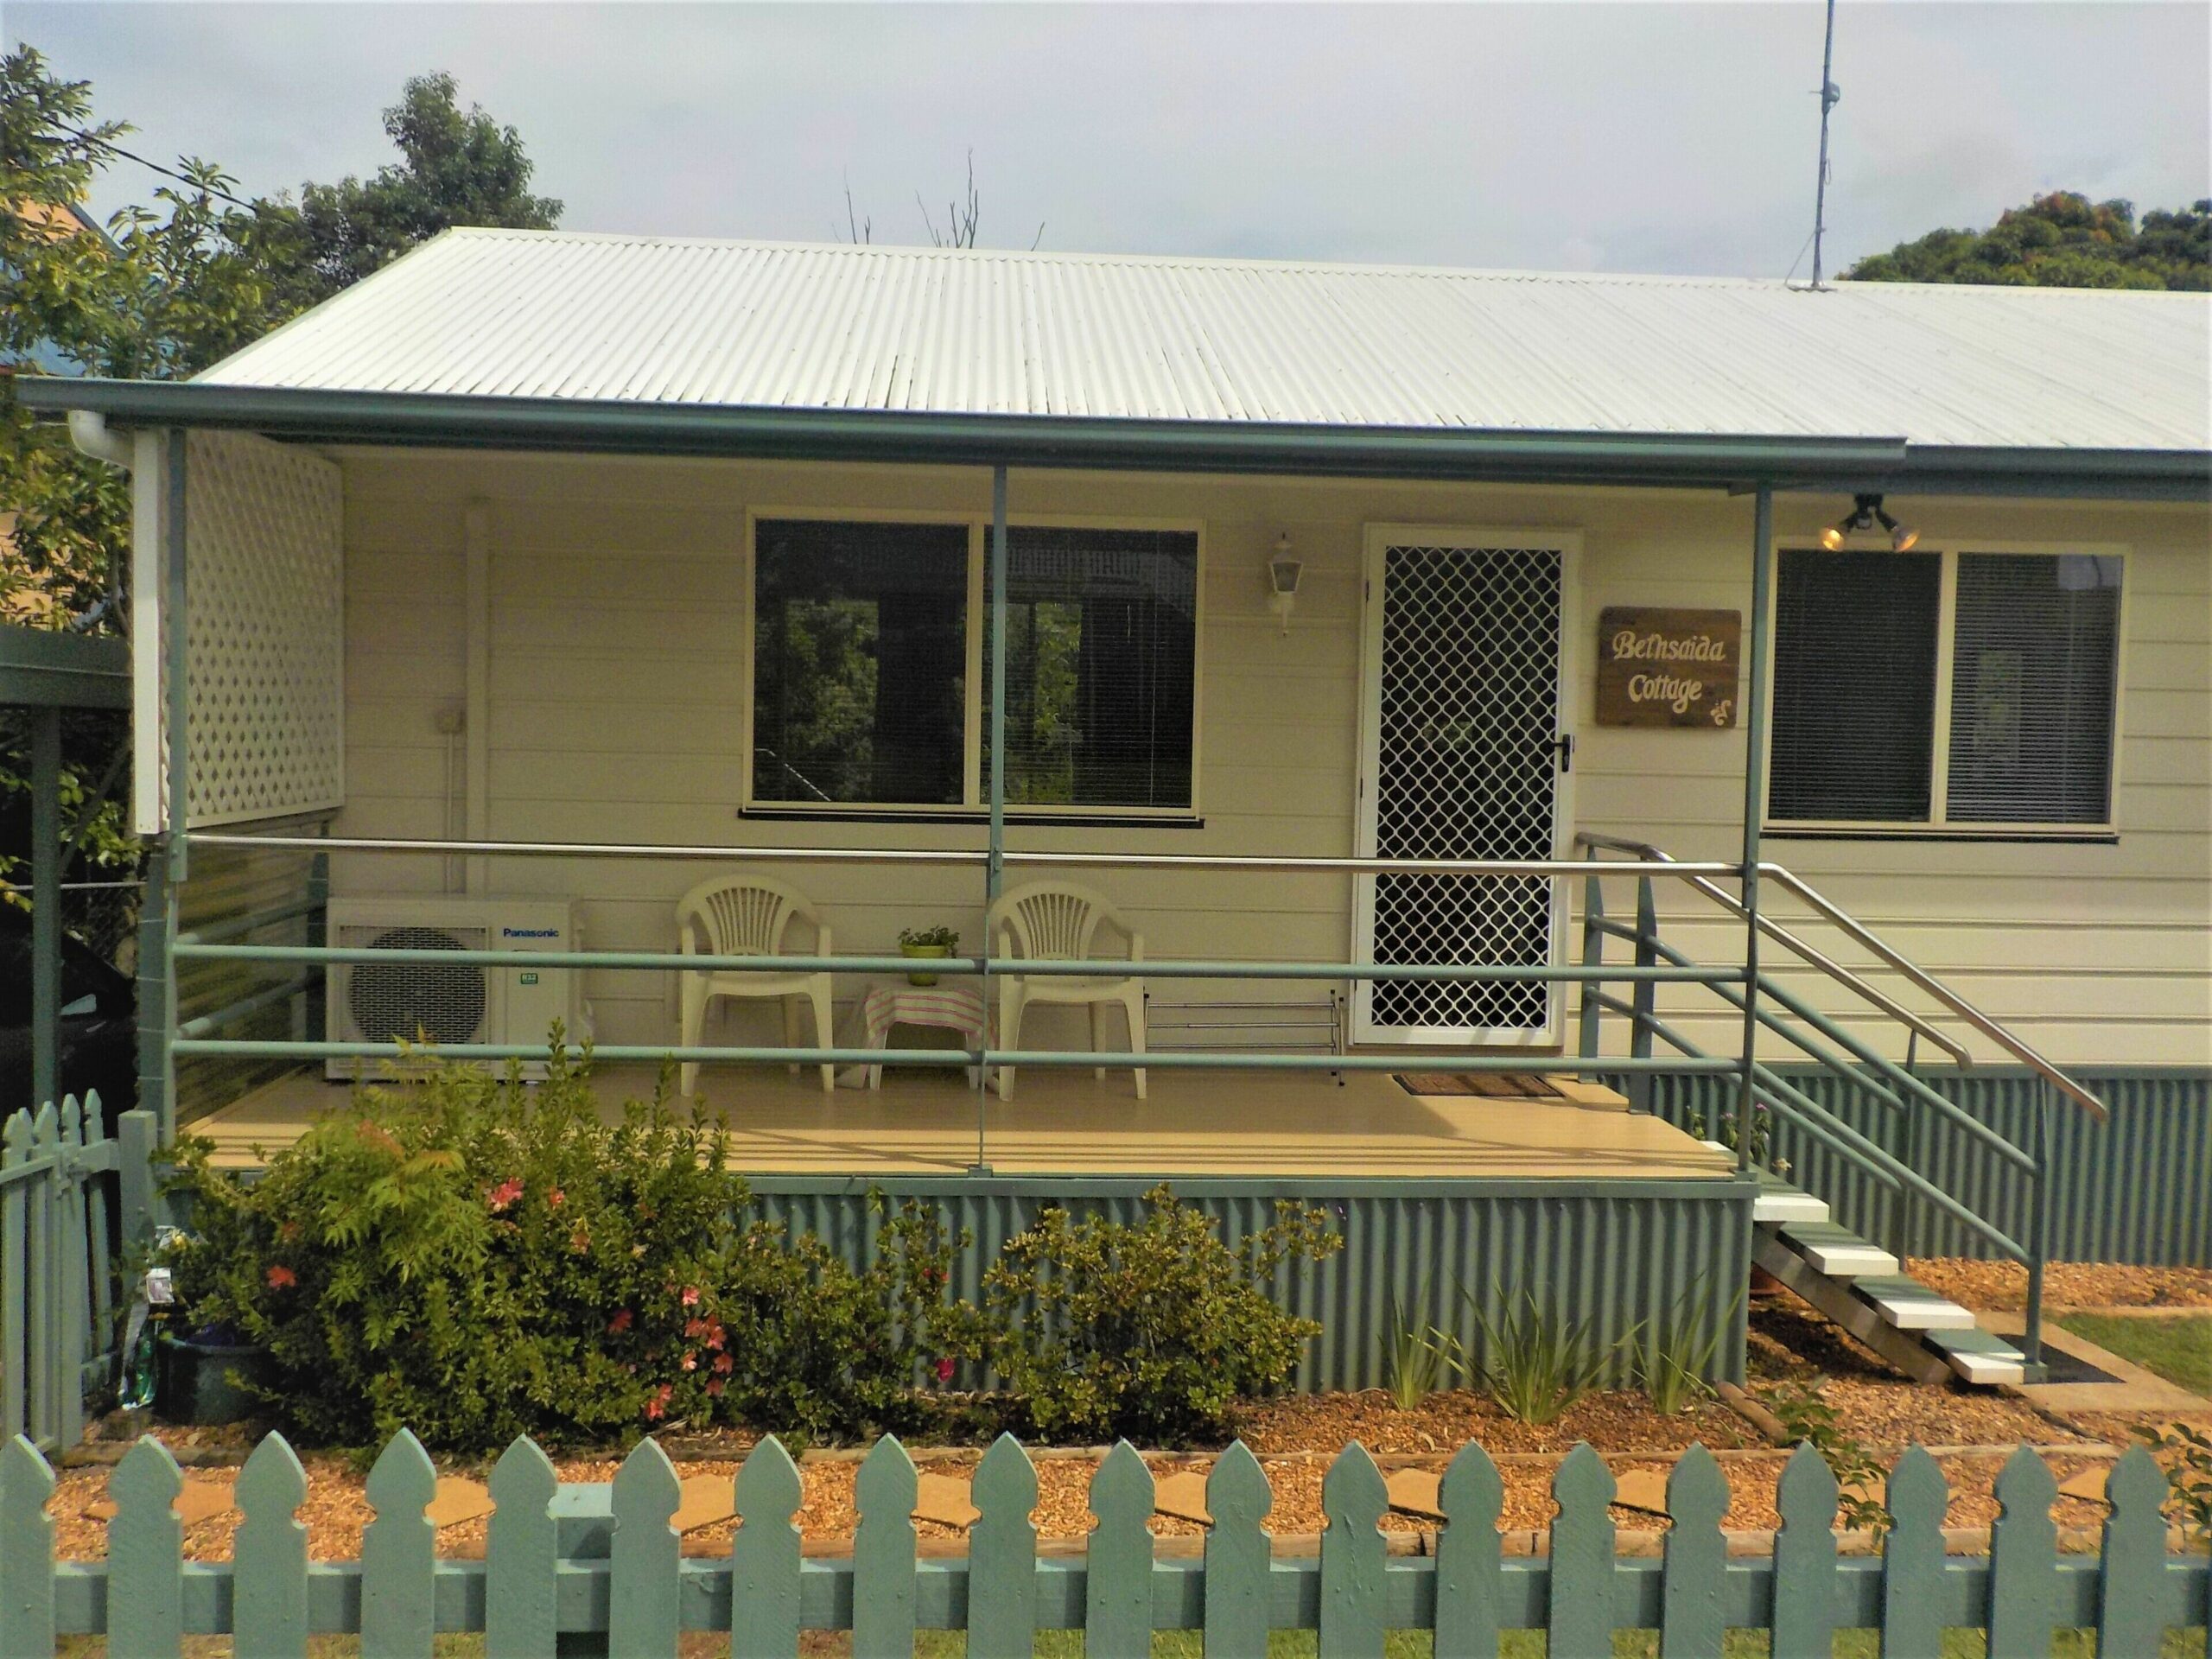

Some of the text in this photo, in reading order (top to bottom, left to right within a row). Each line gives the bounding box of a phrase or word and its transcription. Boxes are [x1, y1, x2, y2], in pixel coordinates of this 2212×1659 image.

[1612, 630, 1726, 661] Bethsaida
[1628, 674, 1703, 714] Cottage
[503, 928, 559, 938] Panasonic
